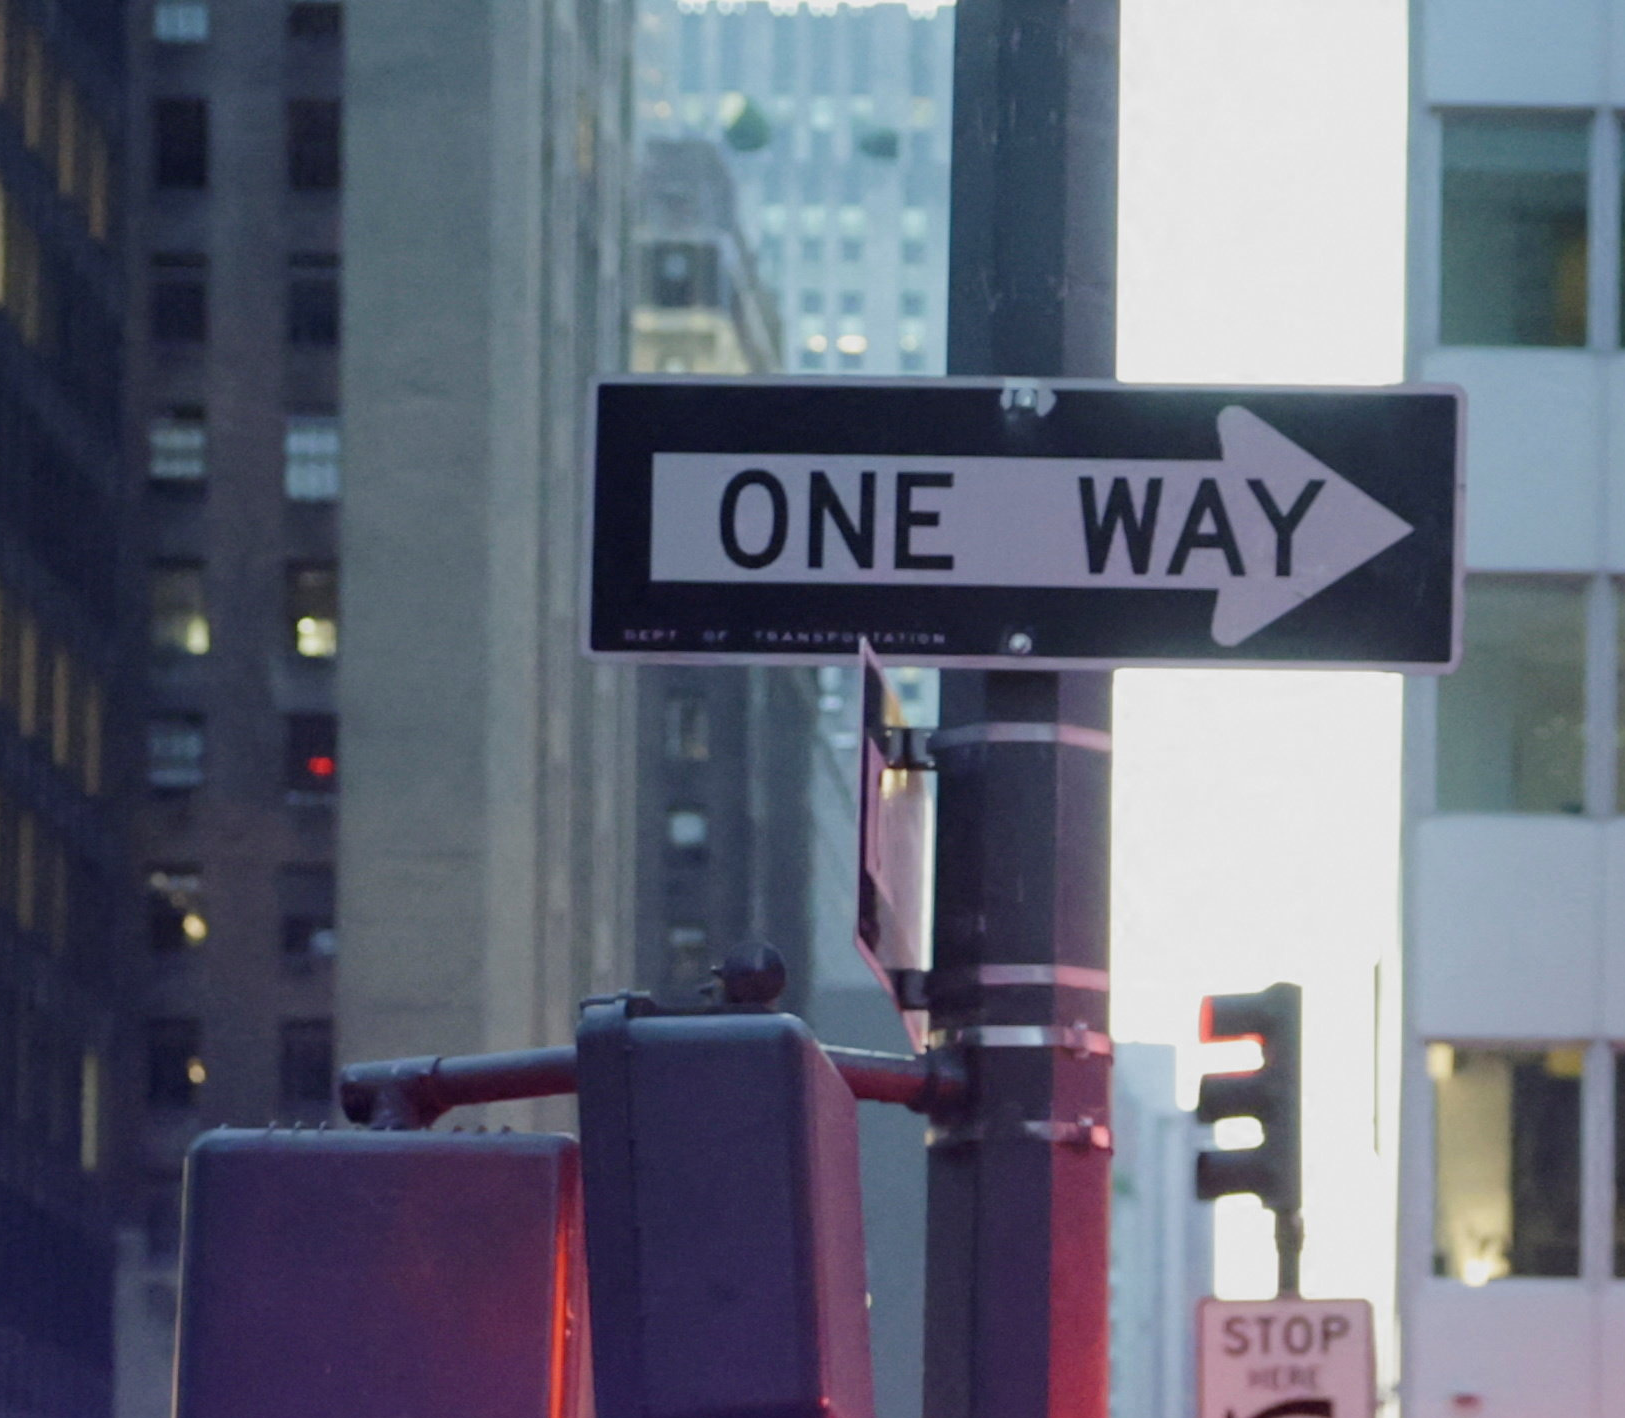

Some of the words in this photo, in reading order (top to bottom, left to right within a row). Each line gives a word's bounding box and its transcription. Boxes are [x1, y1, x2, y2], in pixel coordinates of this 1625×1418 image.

[719, 468, 954, 571] ONE
[1078, 476, 1326, 577] WAY
[1224, 1315, 1351, 1357] STOP
